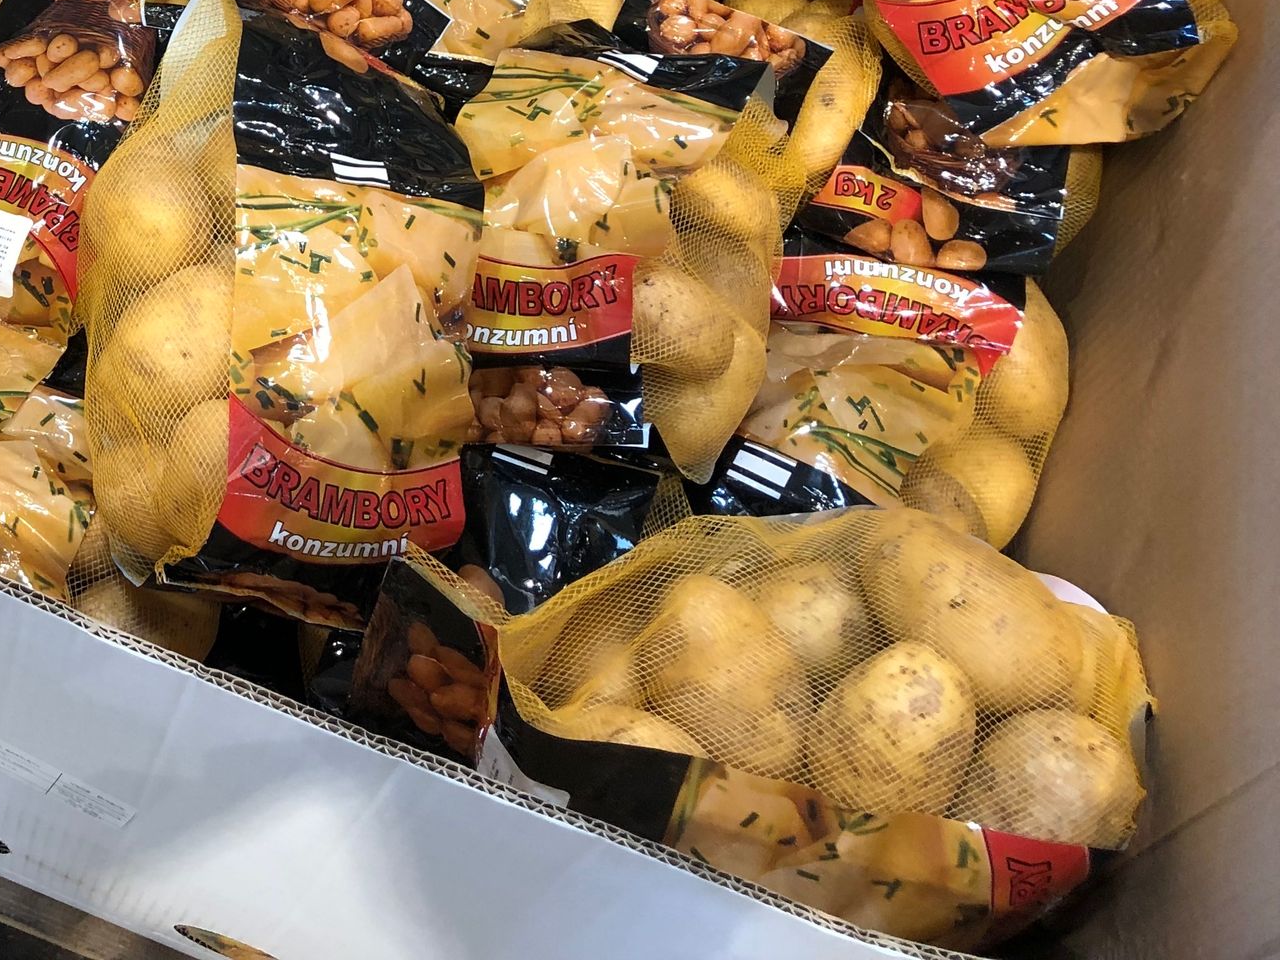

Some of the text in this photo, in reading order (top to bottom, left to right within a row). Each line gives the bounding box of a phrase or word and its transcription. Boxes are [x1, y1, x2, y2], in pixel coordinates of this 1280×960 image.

[833, 171, 897, 211] 2 kg
[471, 264, 618, 317] AMBORY
[824, 259, 975, 308] konzumní
[467, 317, 578, 346] nzumní
[240, 442, 452, 529] BRAMBORY
[268, 520, 409, 559] konzumní
